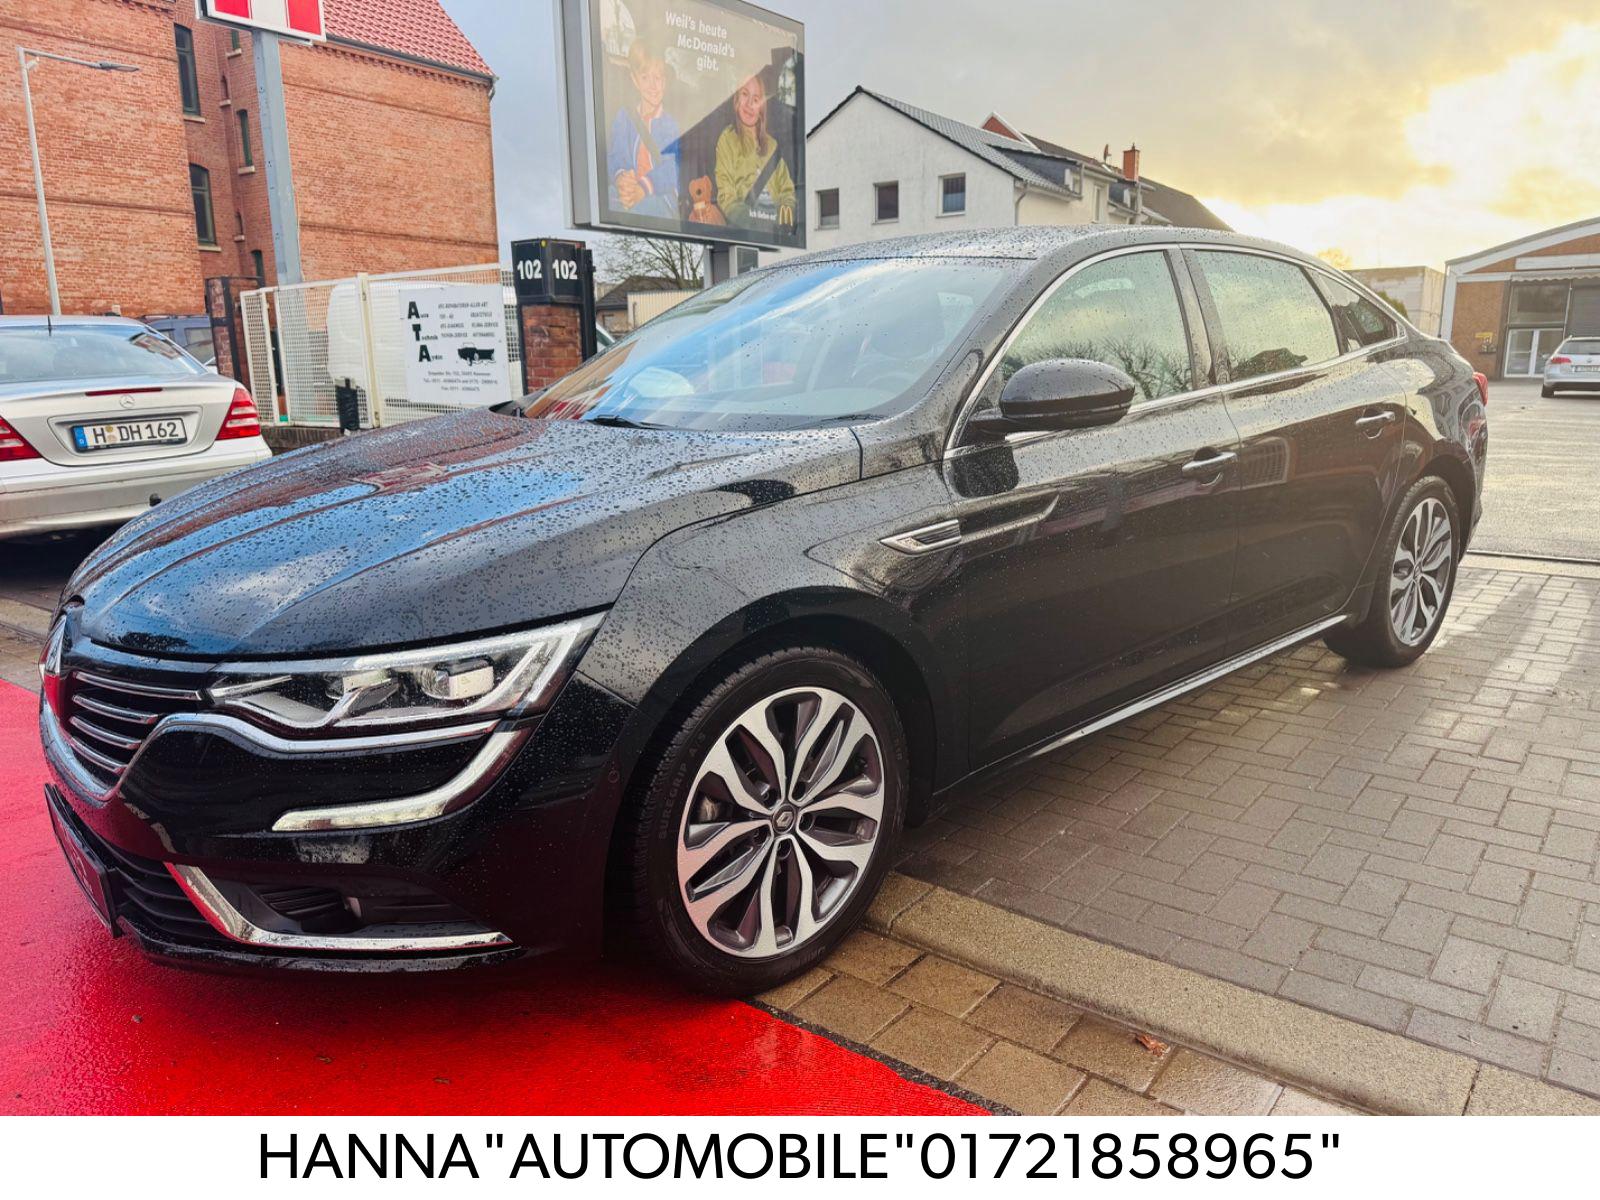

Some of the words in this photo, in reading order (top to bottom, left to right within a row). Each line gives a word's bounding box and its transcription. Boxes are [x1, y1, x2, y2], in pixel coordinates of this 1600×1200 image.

[665, 9, 696, 31] Weil's
[698, 19, 728, 39] heute
[677, 33, 735, 58] McDonald's
[517, 259, 542, 280] 102
[552, 259, 578, 280] 102
[93, 425, 106, 443] H
[117, 424, 142, 441] DH
[145, 421, 179, 439] 162
